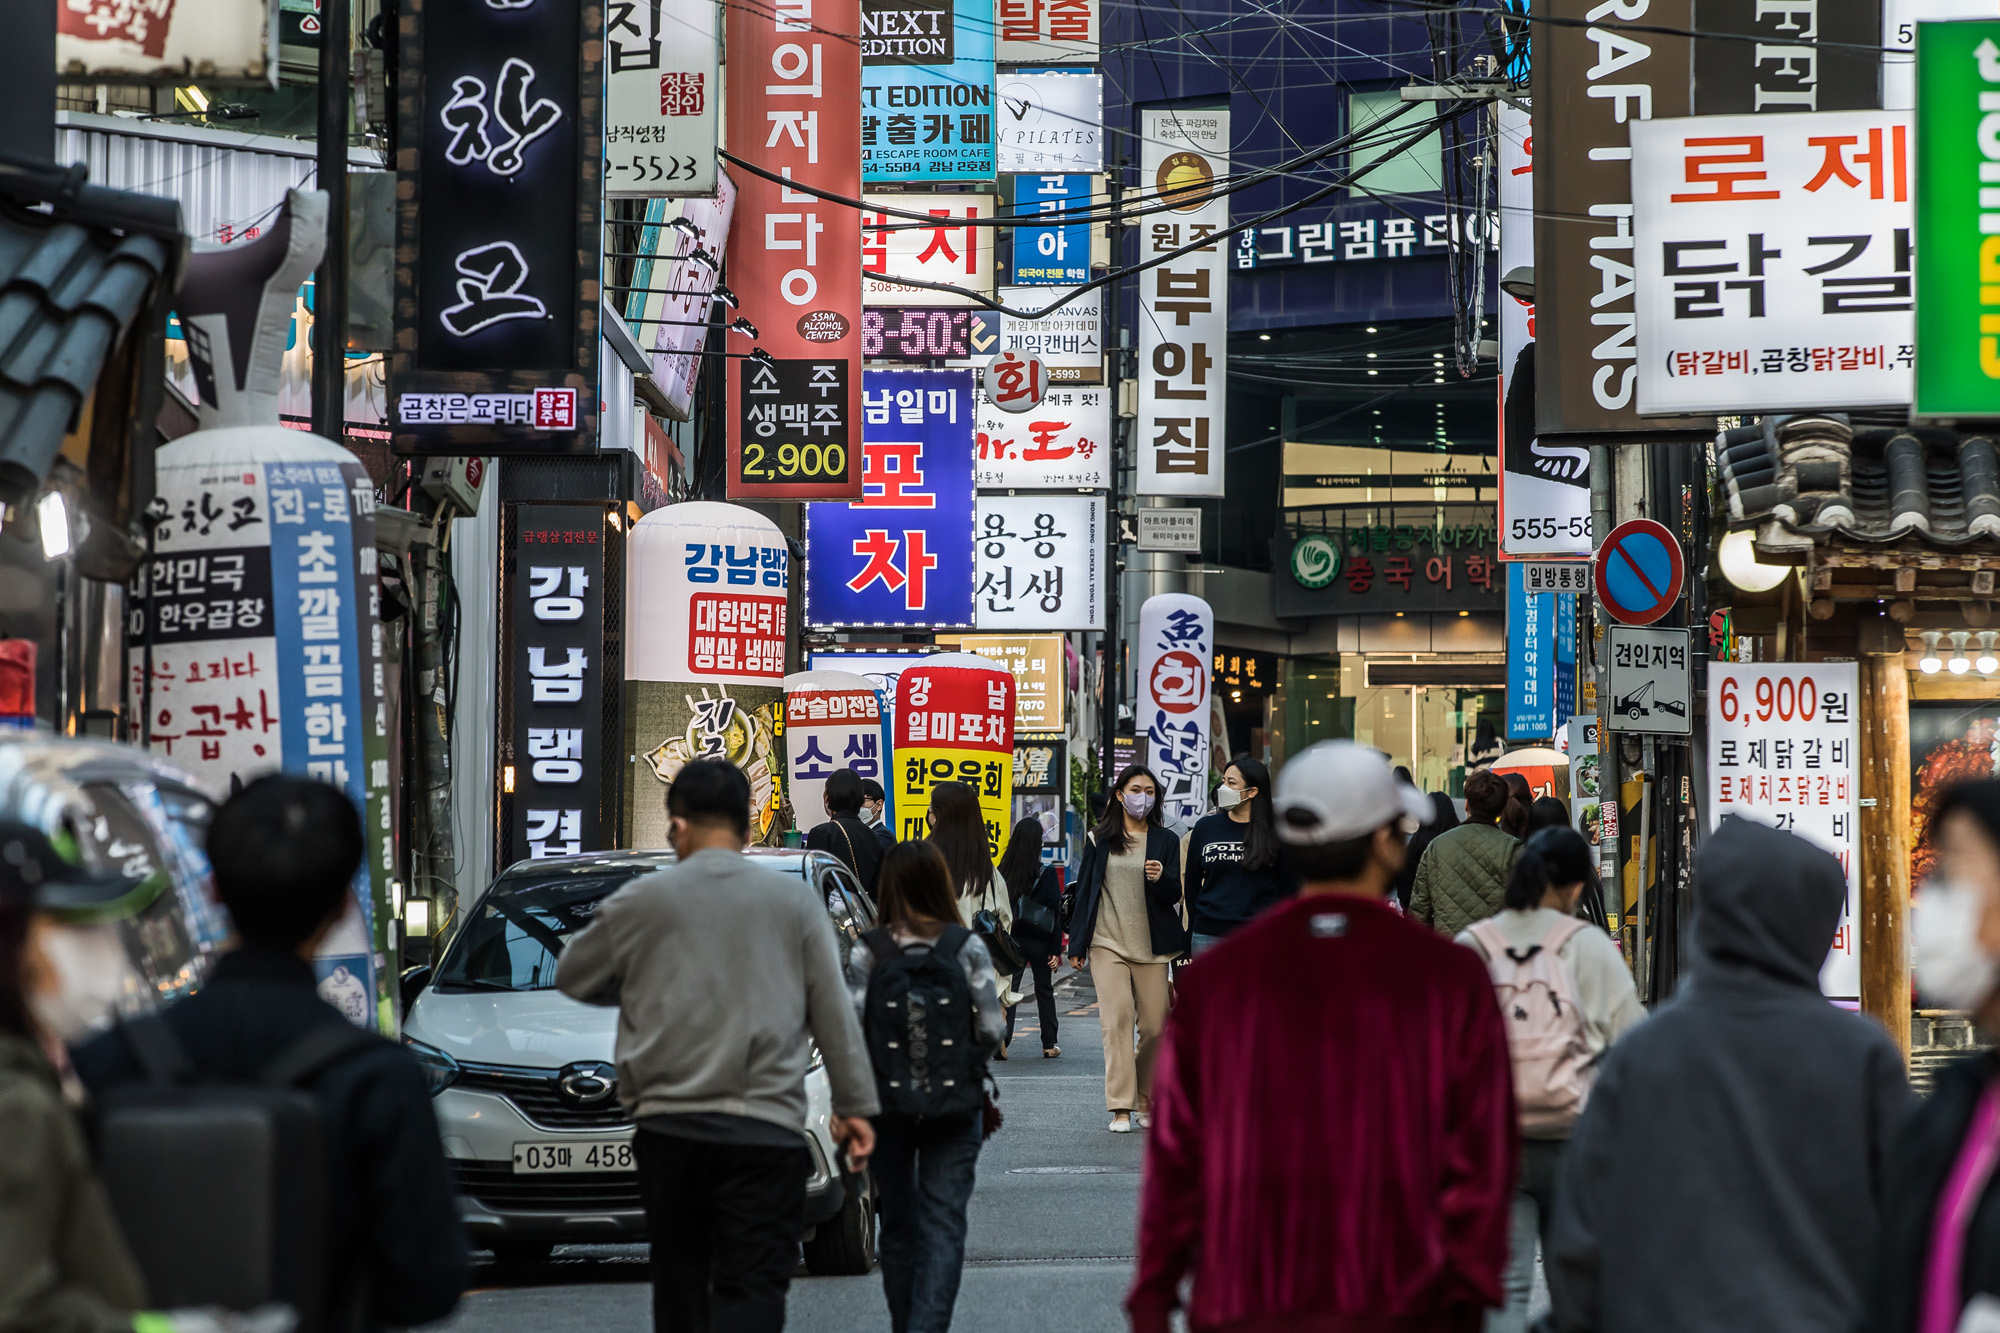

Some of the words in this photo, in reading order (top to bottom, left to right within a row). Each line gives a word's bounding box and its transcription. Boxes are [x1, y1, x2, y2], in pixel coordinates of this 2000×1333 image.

[862, 10, 945, 36] NEXT
[862, 38, 946, 56] EDITION
[888, 85, 990, 107] EDITION
[1160, 118, 1184, 127] 전라도
[1186, 119, 1217, 128] 파김치와
[1160, 130, 1200, 139] 숙성고기의
[1201, 130, 1217, 139] 만남
[1017, 129, 1094, 144] PILATES
[876, 150, 920, 159] ESCAPE
[923, 149, 958, 158] ROOM
[961, 148, 990, 158] CAFE
[929, 161, 952, 172] 강남
[957, 160, 991, 172] 2호점
[1670, 125, 1907, 203] 로제
[440, 0, 562, 337] 창고
[1151, 223, 1217, 252] 원조
[1237, 228, 1258, 268] 강남
[1018, 268, 1045, 278] 외국어
[1046, 268, 1064, 278] 전문
[1066, 268, 1085, 278] 학원
[811, 313, 837, 322] SSAN
[1052, 307, 1098, 316] ANVAS
[803, 321, 843, 331] ALCOHOL
[805, 330, 841, 340] CENTER
[1006, 320, 1098, 331] 게임개발아카데미
[1006, 335, 1098, 355] 게임캔버스
[994, 352, 1040, 403] 회
[1153, 268, 1212, 475] 부안집
[403, 397, 468, 420] 곱창은
[472, 398, 533, 421] 요리다
[1042, 393, 1074, 406] 베큐
[1081, 393, 1099, 406] 맛!
[747, 404, 842, 437] 생맥주
[743, 443, 845, 480] 2,900
[1077, 438, 1097, 460] 왕
[846, 441, 937, 610] 포차
[977, 513, 1067, 559] 용용
[1511, 516, 1592, 540] 555-58
[1345, 554, 1495, 592] 중국어학
[1530, 567, 1586, 588] 일방통행
[977, 565, 1064, 613] 선생
[159, 598, 265, 633] 한우곱창
[696, 600, 773, 635] 대한민국
[185, 651, 261, 683] 요리다
[1615, 643, 1685, 670] 견인지역
[1153, 656, 1202, 706] 회
[526, 565, 589, 860] 강남랭겹
[788, 693, 879, 721] 싼술의전당
[1018, 700, 1045, 711] 7870
[130, 689, 279, 761] 우곱창
[908, 711, 1006, 746] 일미포차
[1719, 737, 1849, 770] 로제닭갈비
[1719, 774, 1849, 805] 로제치즈닭갈비
[1205, 855, 1218, 863] by
[527, 1145, 572, 1169] 03마
[585, 1144, 632, 1168] 458
